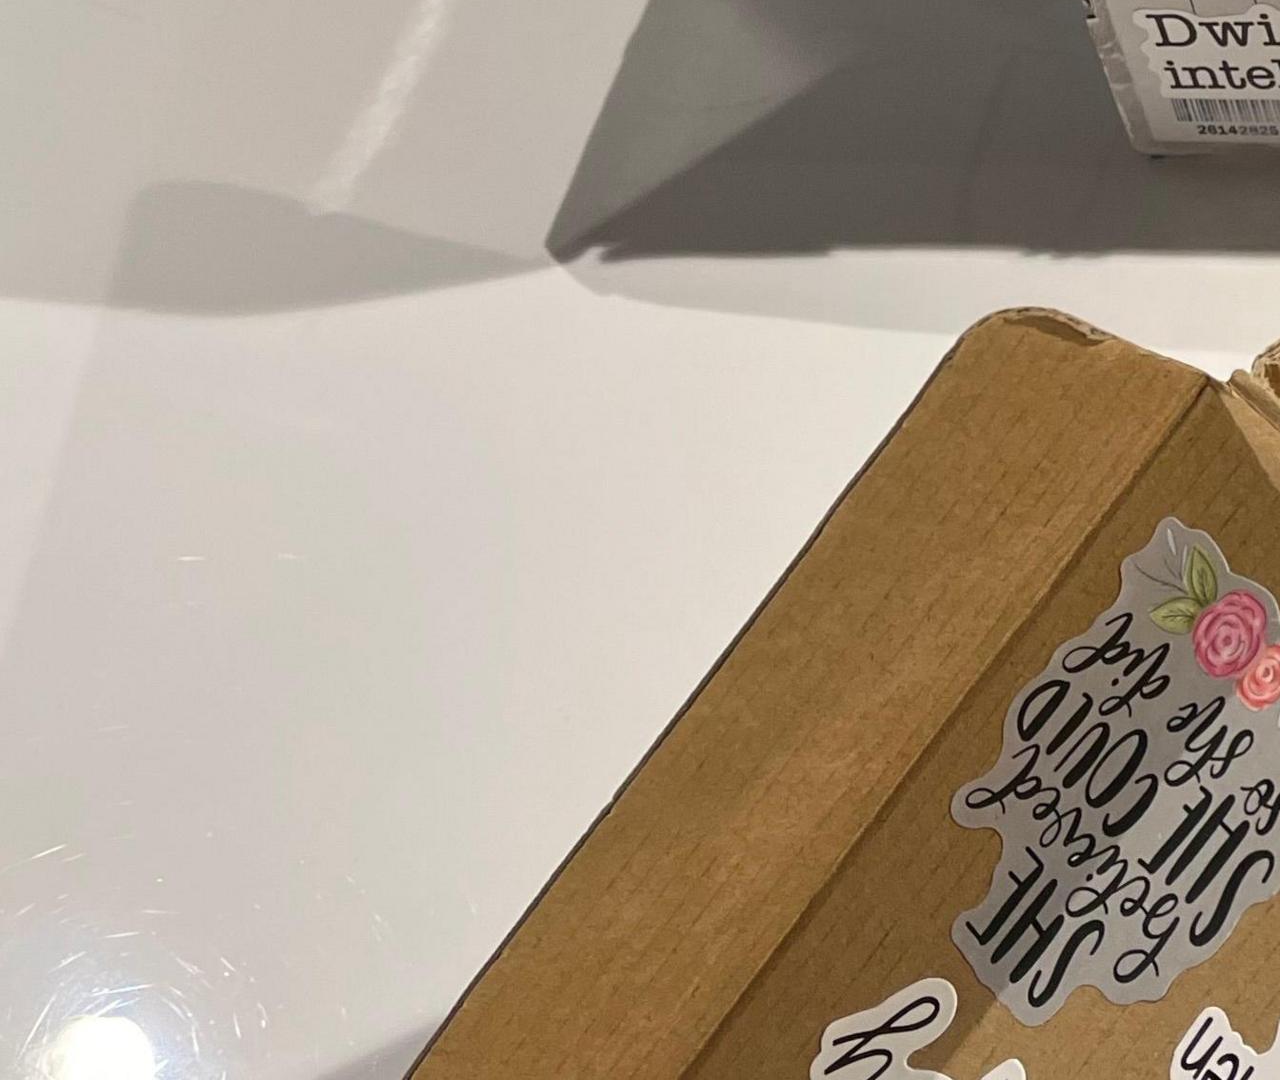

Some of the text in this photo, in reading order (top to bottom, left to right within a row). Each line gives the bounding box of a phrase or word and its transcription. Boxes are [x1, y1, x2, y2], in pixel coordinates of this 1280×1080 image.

[1063, 612, 1171, 718] did
[1165, 696, 1255, 787] she
[966, 744, 1181, 983] believed
[1018, 680, 1275, 947] SHE COULD
[966, 846, 1104, 1008] SHE
